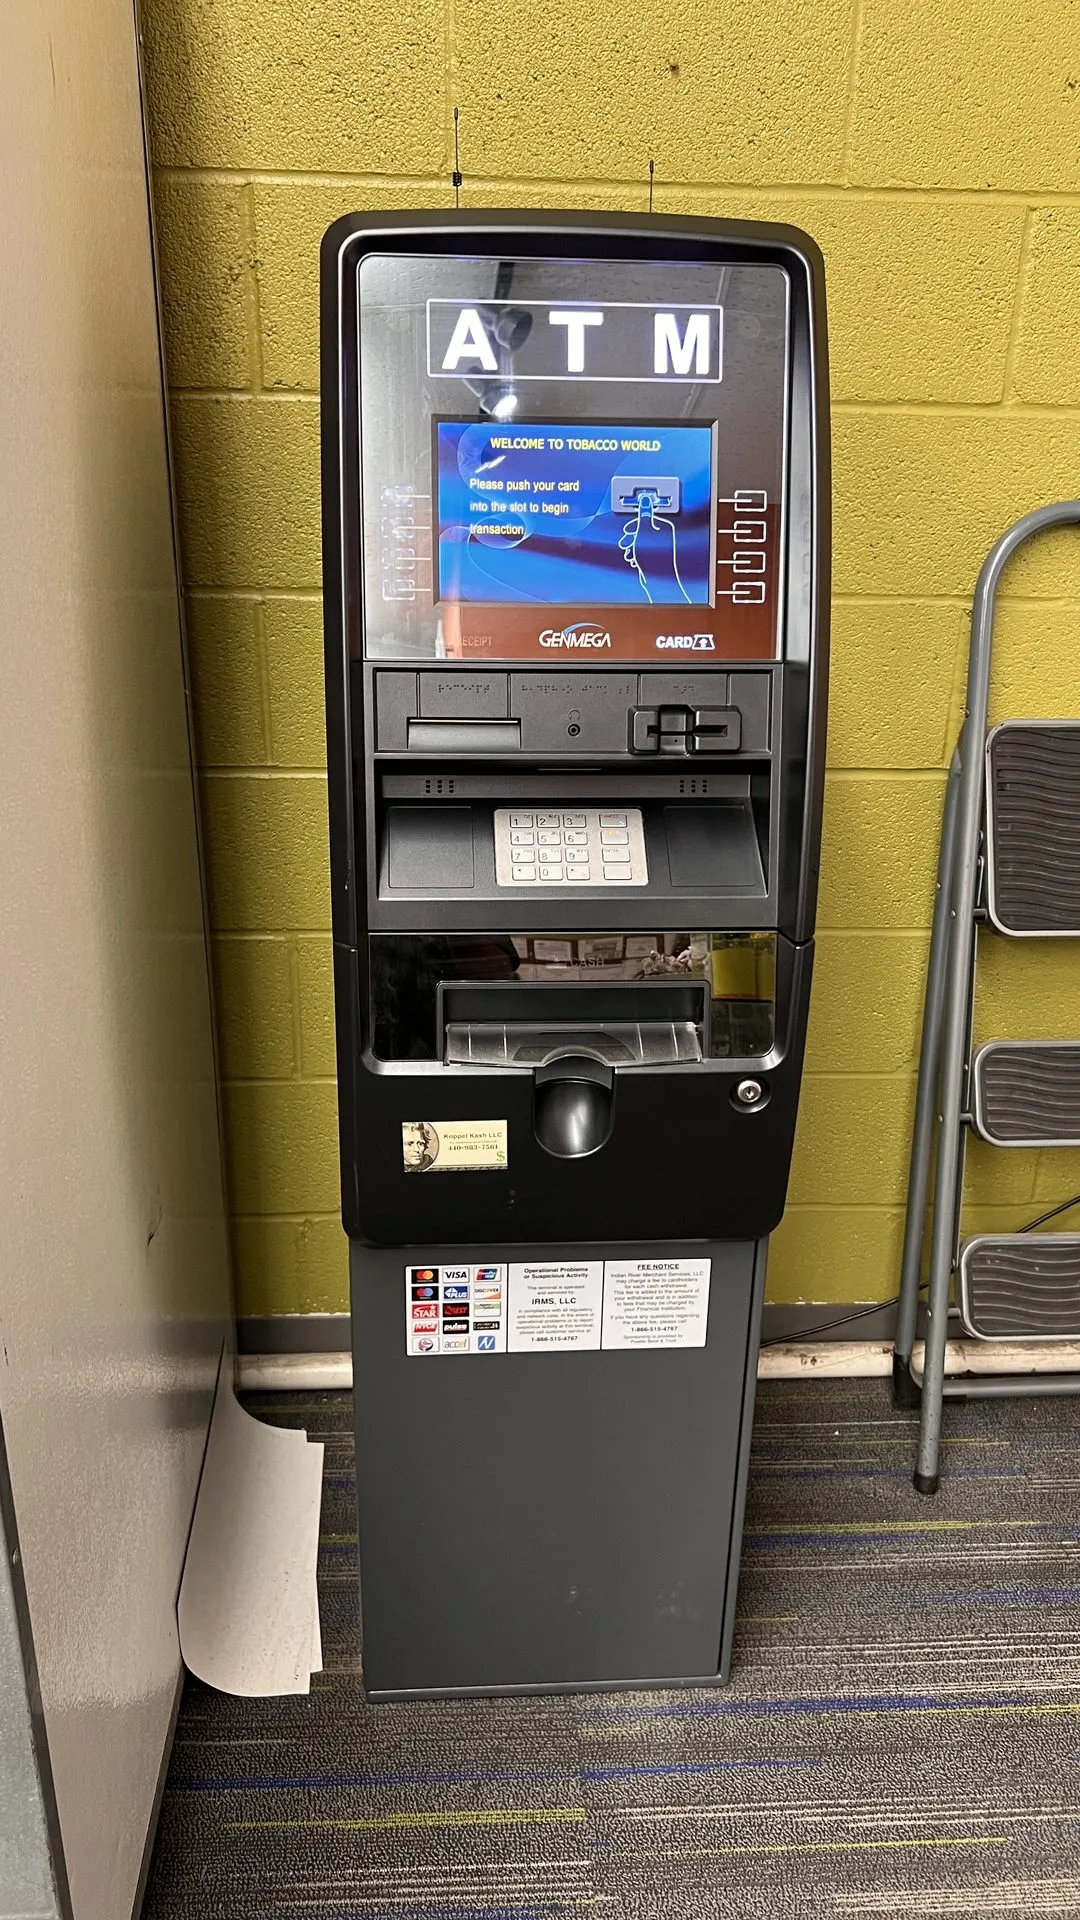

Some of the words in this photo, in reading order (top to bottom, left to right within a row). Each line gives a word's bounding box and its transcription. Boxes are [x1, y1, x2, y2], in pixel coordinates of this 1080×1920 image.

[490, 437, 544, 450] WELCOME
[547, 439, 564, 450] TO
[566, 439, 618, 450] TOBACCO
[621, 440, 661, 451] WORLD
[470, 479, 503, 490] Please
[507, 480, 530, 492] push
[533, 481, 555, 492] your
[558, 480, 579, 491] card
[470, 502, 487, 511] into
[491, 502, 506, 512] the
[510, 502, 527, 512] slot
[530, 502, 539, 512] to
[542, 502, 569, 515] begin
[470, 524, 524, 535] transaction
[538, 629, 611, 649] GENMEGA
[656, 635, 692, 648] CARD
[413, 1309, 436, 1318] STAR
